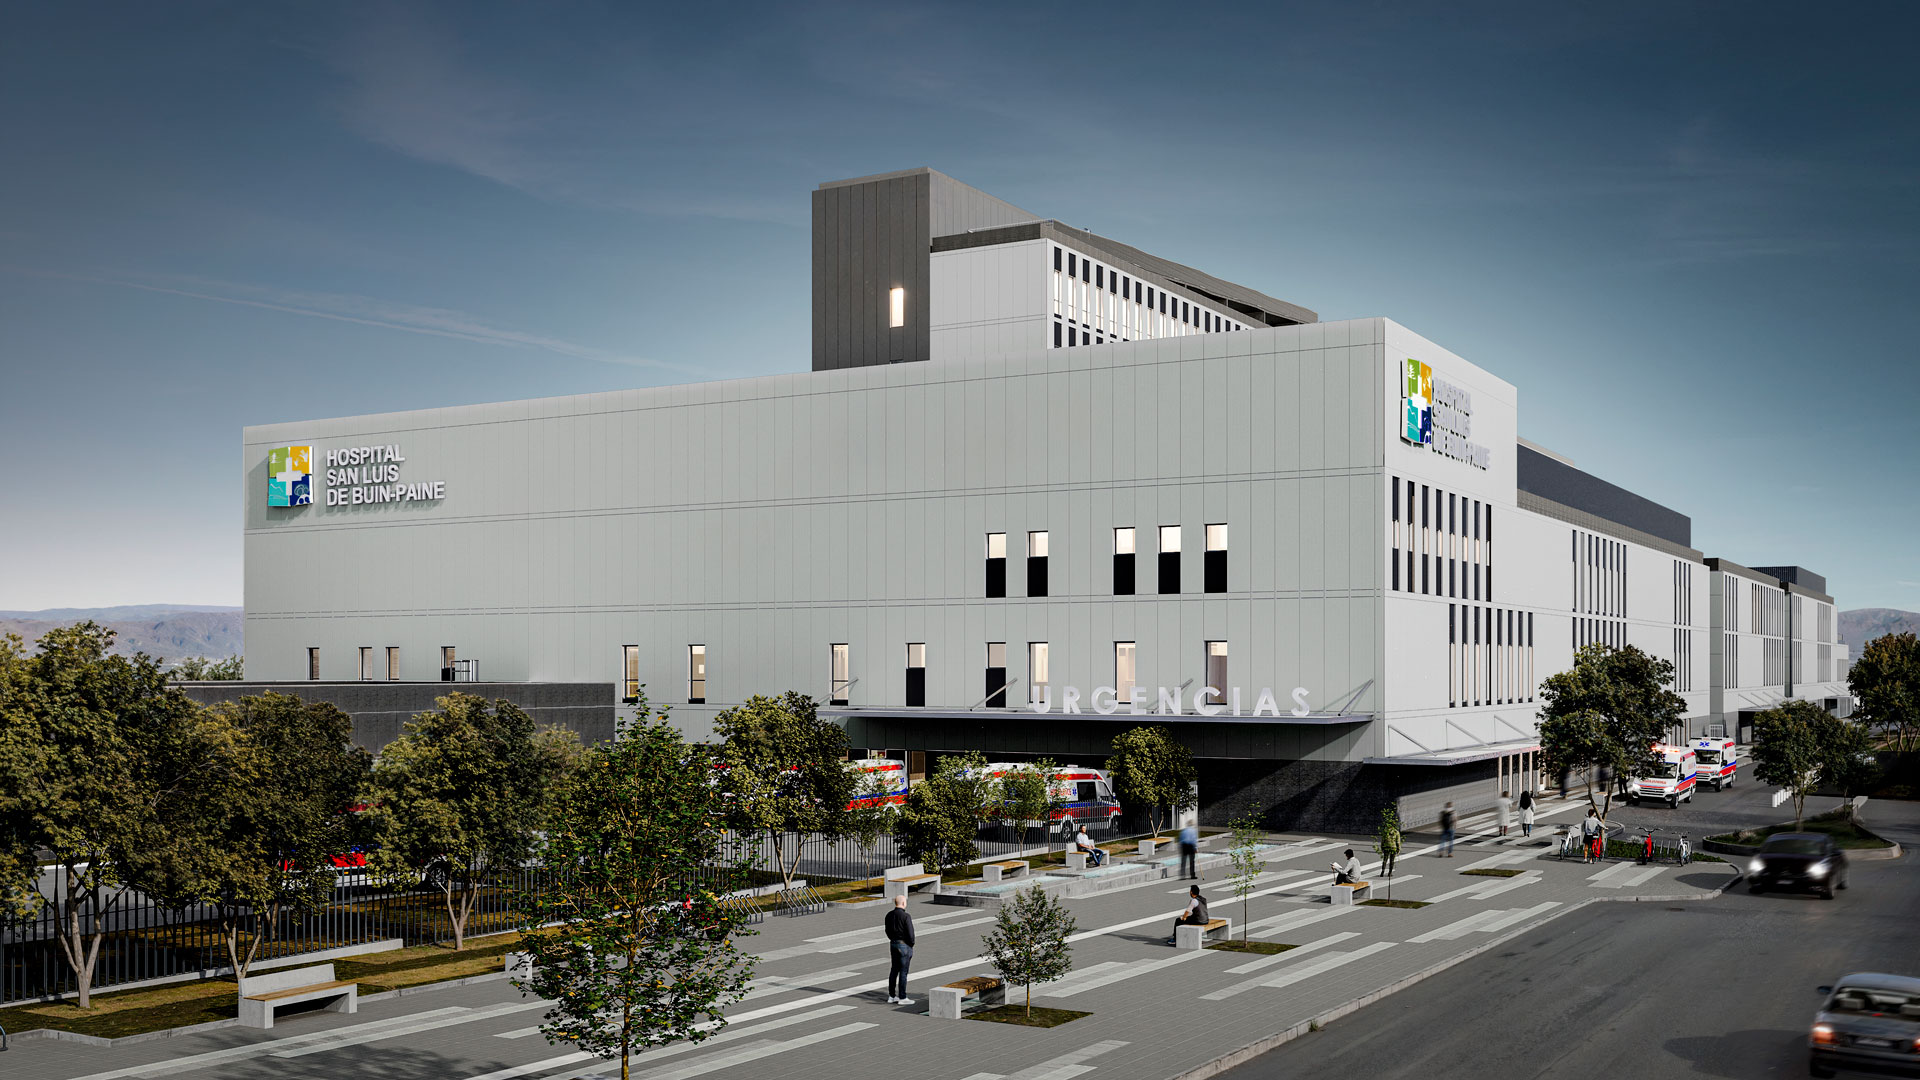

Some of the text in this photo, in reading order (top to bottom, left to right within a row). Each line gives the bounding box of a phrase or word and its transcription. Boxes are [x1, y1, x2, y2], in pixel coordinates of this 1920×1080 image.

[326, 444, 405, 467] HOSPITAL
[326, 464, 400, 487] SAN LUIS
[326, 481, 445, 506] DE BUIN-PAINE
[1032, 686, 1310, 717] URGENCIAS
